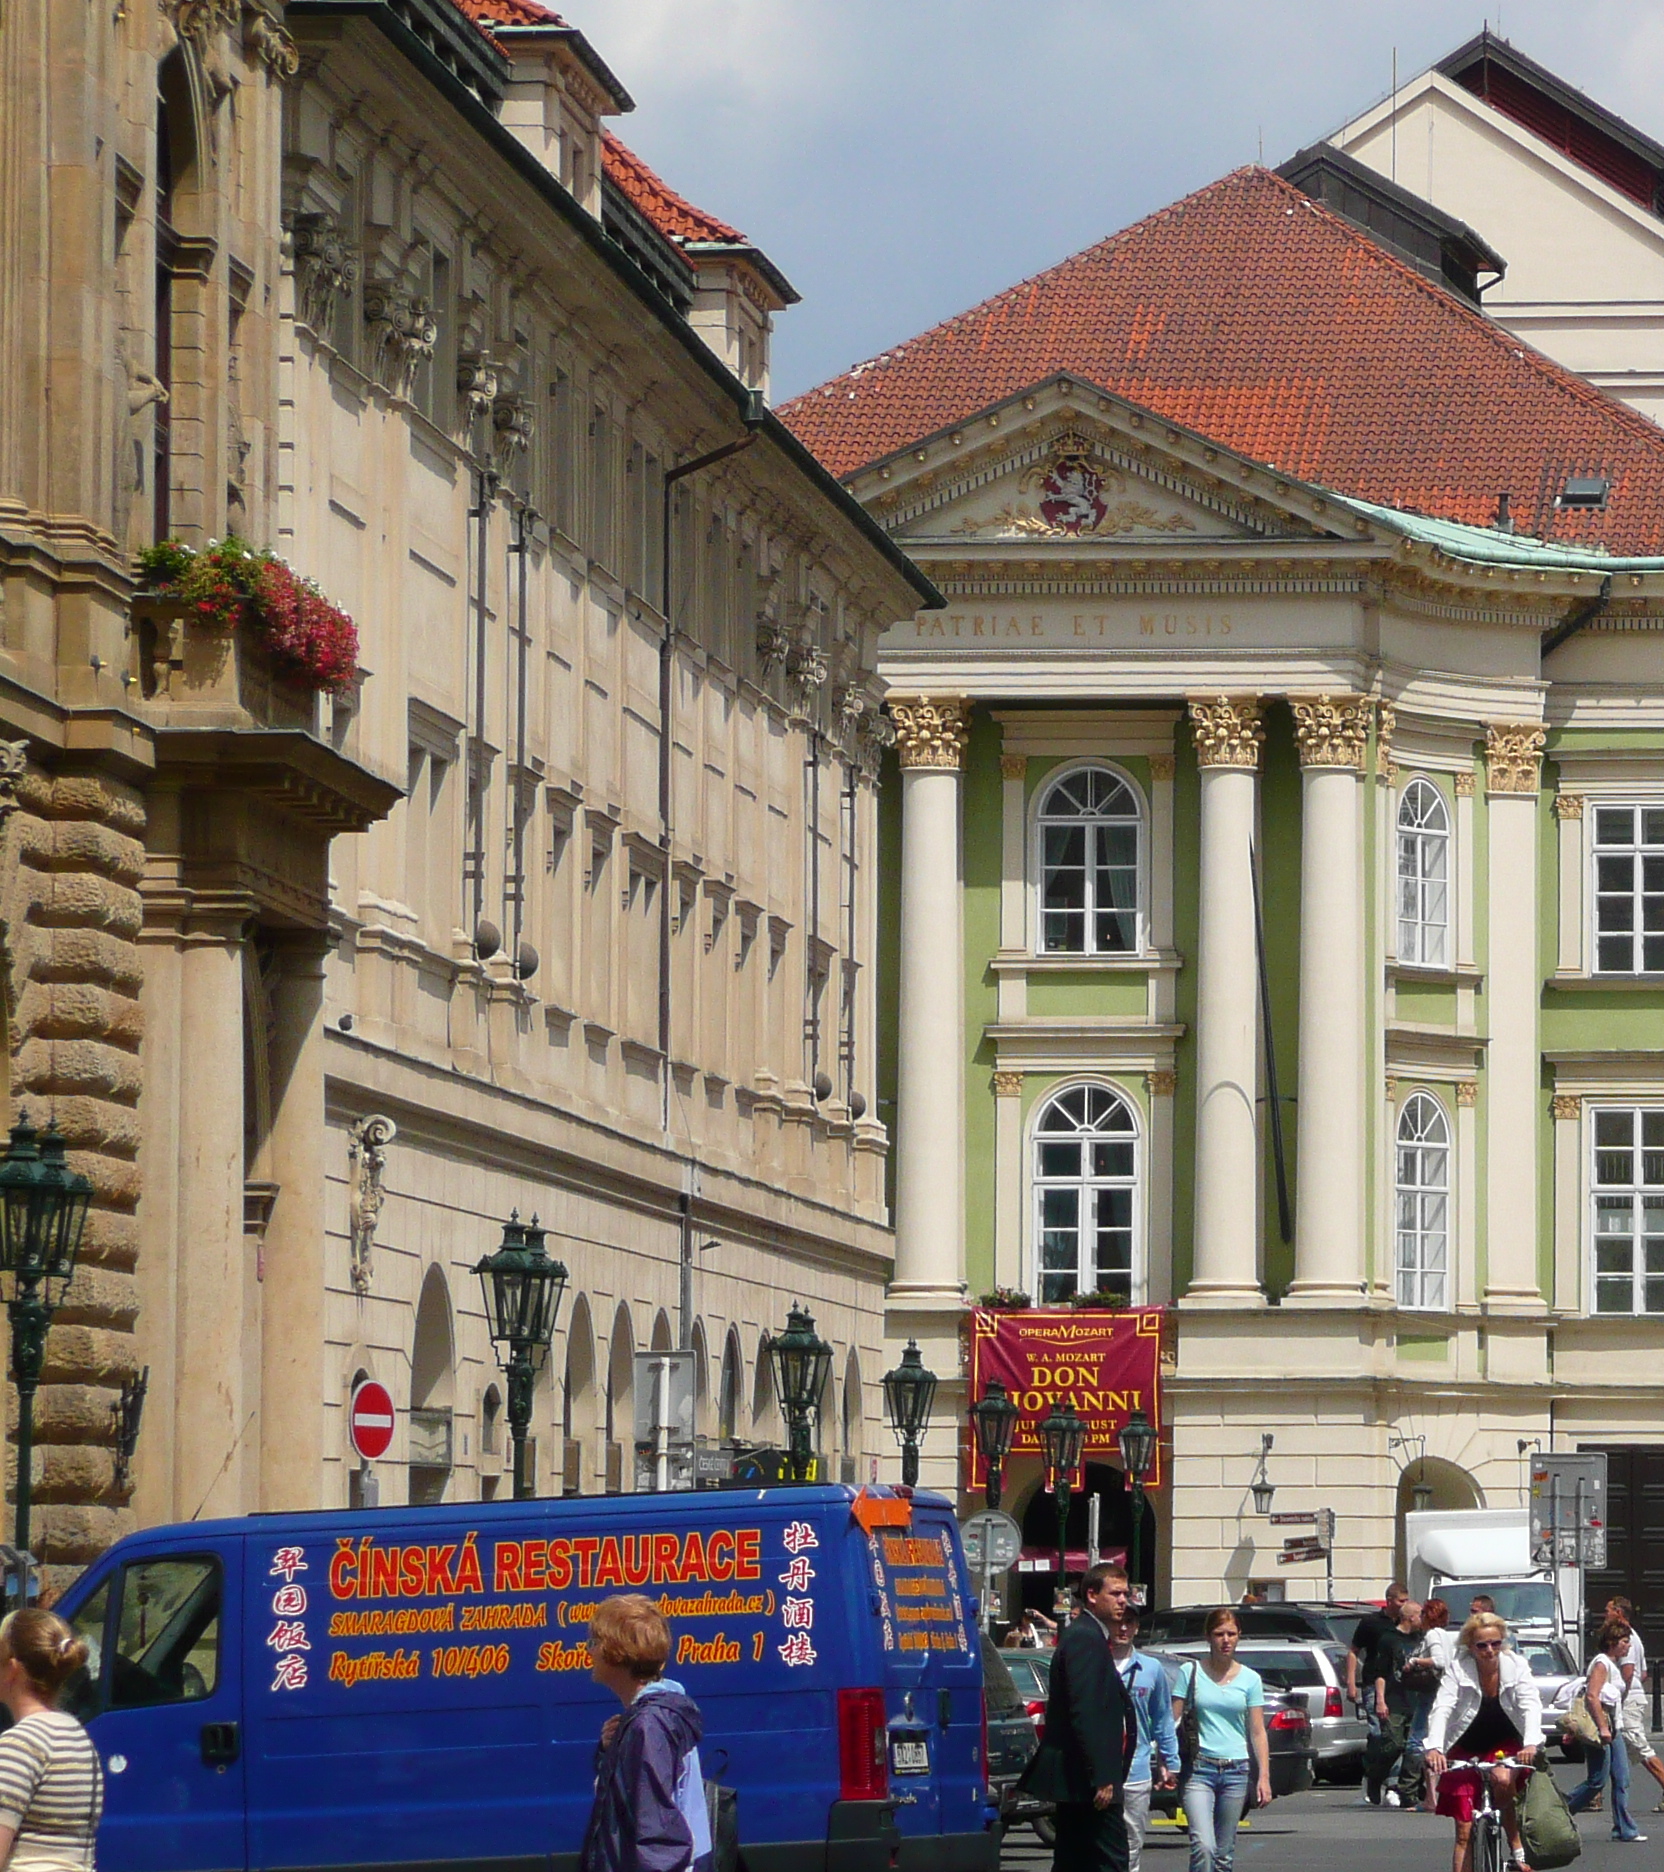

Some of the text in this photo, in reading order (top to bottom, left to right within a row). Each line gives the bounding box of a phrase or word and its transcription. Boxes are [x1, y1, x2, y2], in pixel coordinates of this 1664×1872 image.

[915, 614, 1233, 637] PATRIAE ET MUSIS
[1026, 1353, 1106, 1362] W. A. MOZART
[1031, 1367, 1100, 1387] DON
[1092, 1434, 1110, 1443] PM
[329, 1529, 761, 1599] ČÍNSKÁ RESTAURACE
[777, 1521, 819, 1667] 牡丹酒楼
[329, 1603, 455, 1637] SMARAGDOVÁ
[460, 1603, 547, 1631] ZAHRADA
[329, 1649, 419, 1687] Rytířská
[432, 1643, 509, 1679] 10/406
[676, 1633, 740, 1664] Praha
[752, 1631, 764, 1661] 1
